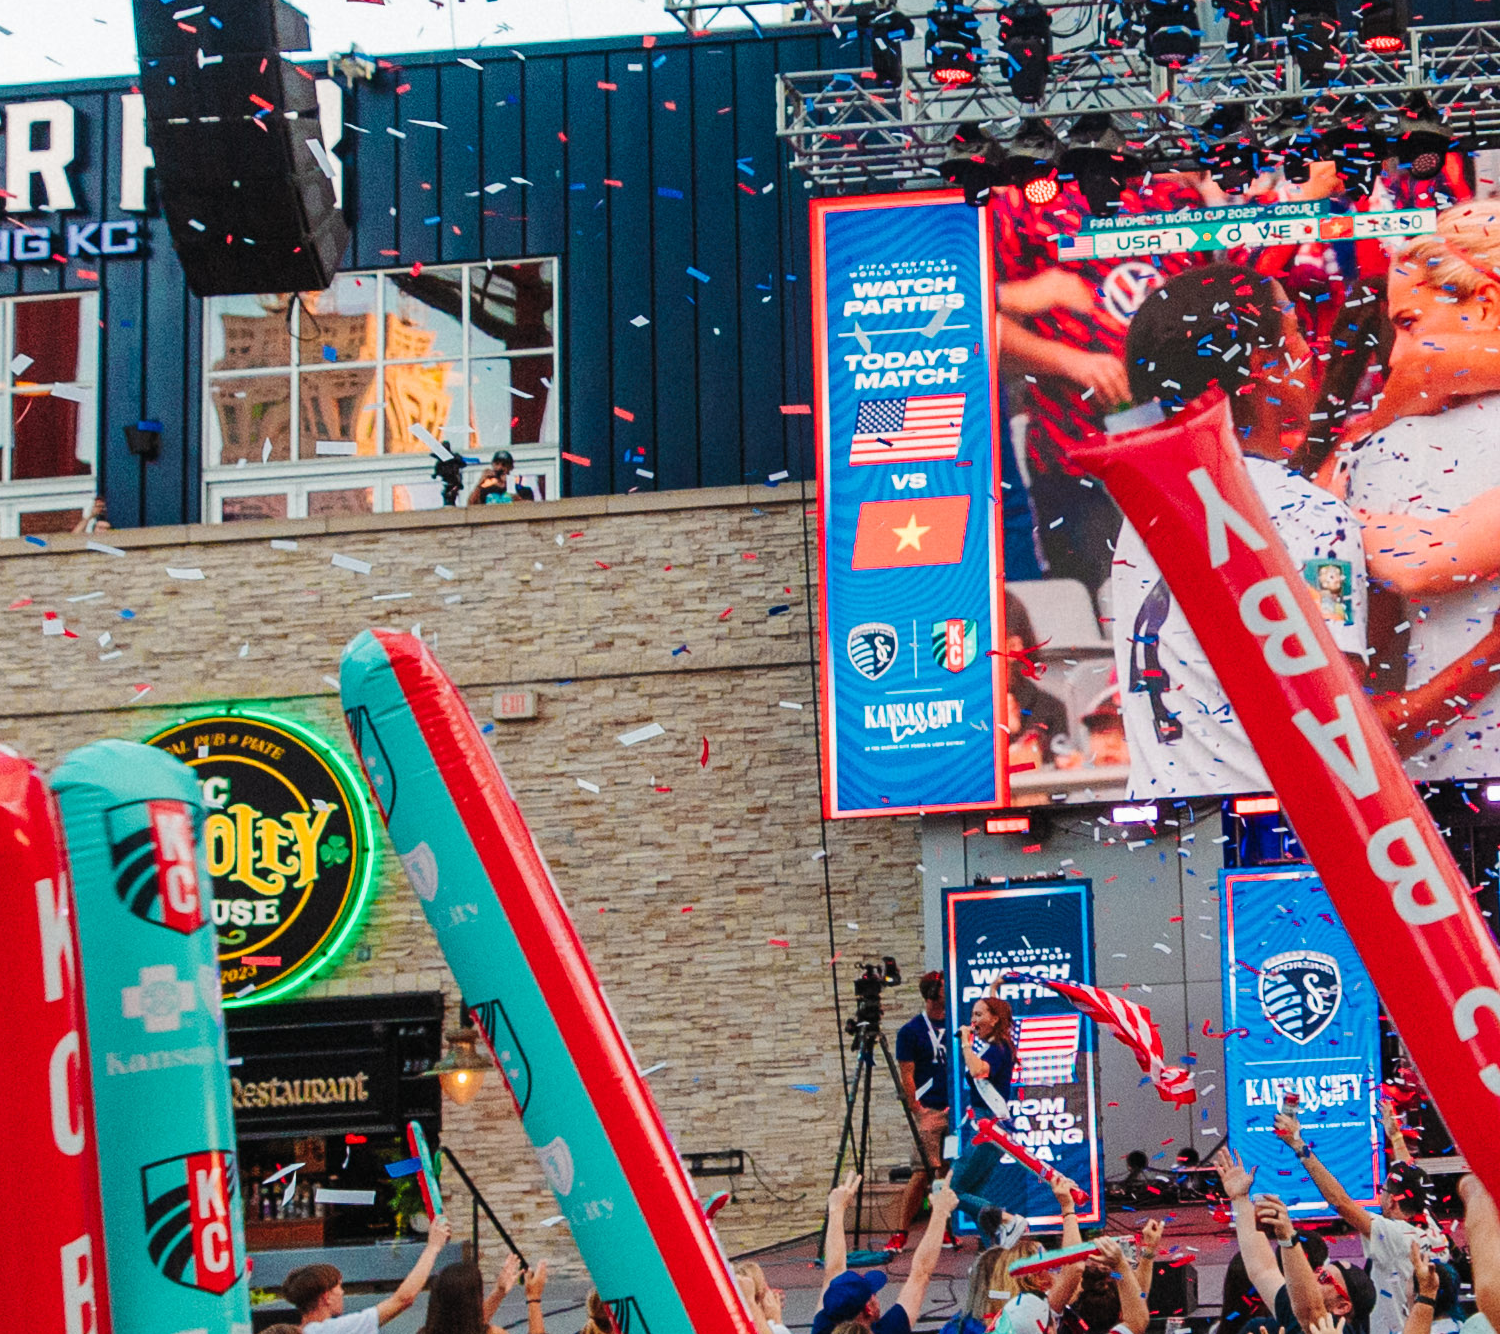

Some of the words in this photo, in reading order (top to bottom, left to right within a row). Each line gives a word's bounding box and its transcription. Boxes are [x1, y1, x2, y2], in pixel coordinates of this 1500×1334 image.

[1090, 219, 1114, 229] FIFA
[1163, 211, 1202, 224] WORLD
[1204, 209, 1226, 221] CUP
[67, 221, 138, 256] KC
[1116, 235, 1162, 251] USA
[1175, 233, 1183, 247] 1
[1257, 224, 1291, 240] VIE
[852, 277, 956, 299] WATCH
[843, 293, 965, 317] PARTIES
[843, 347, 969, 371] TODAY'S
[854, 367, 958, 391] MATCH
[891, 473, 927, 490] VS
[949, 624, 963, 666] KC
[501, 694, 527, 714] EXIT
[1186, 468, 1459, 927] BABY
[197, 776, 231, 809] C
[155, 813, 198, 914] KC
[195, 1168, 232, 1274] KC
